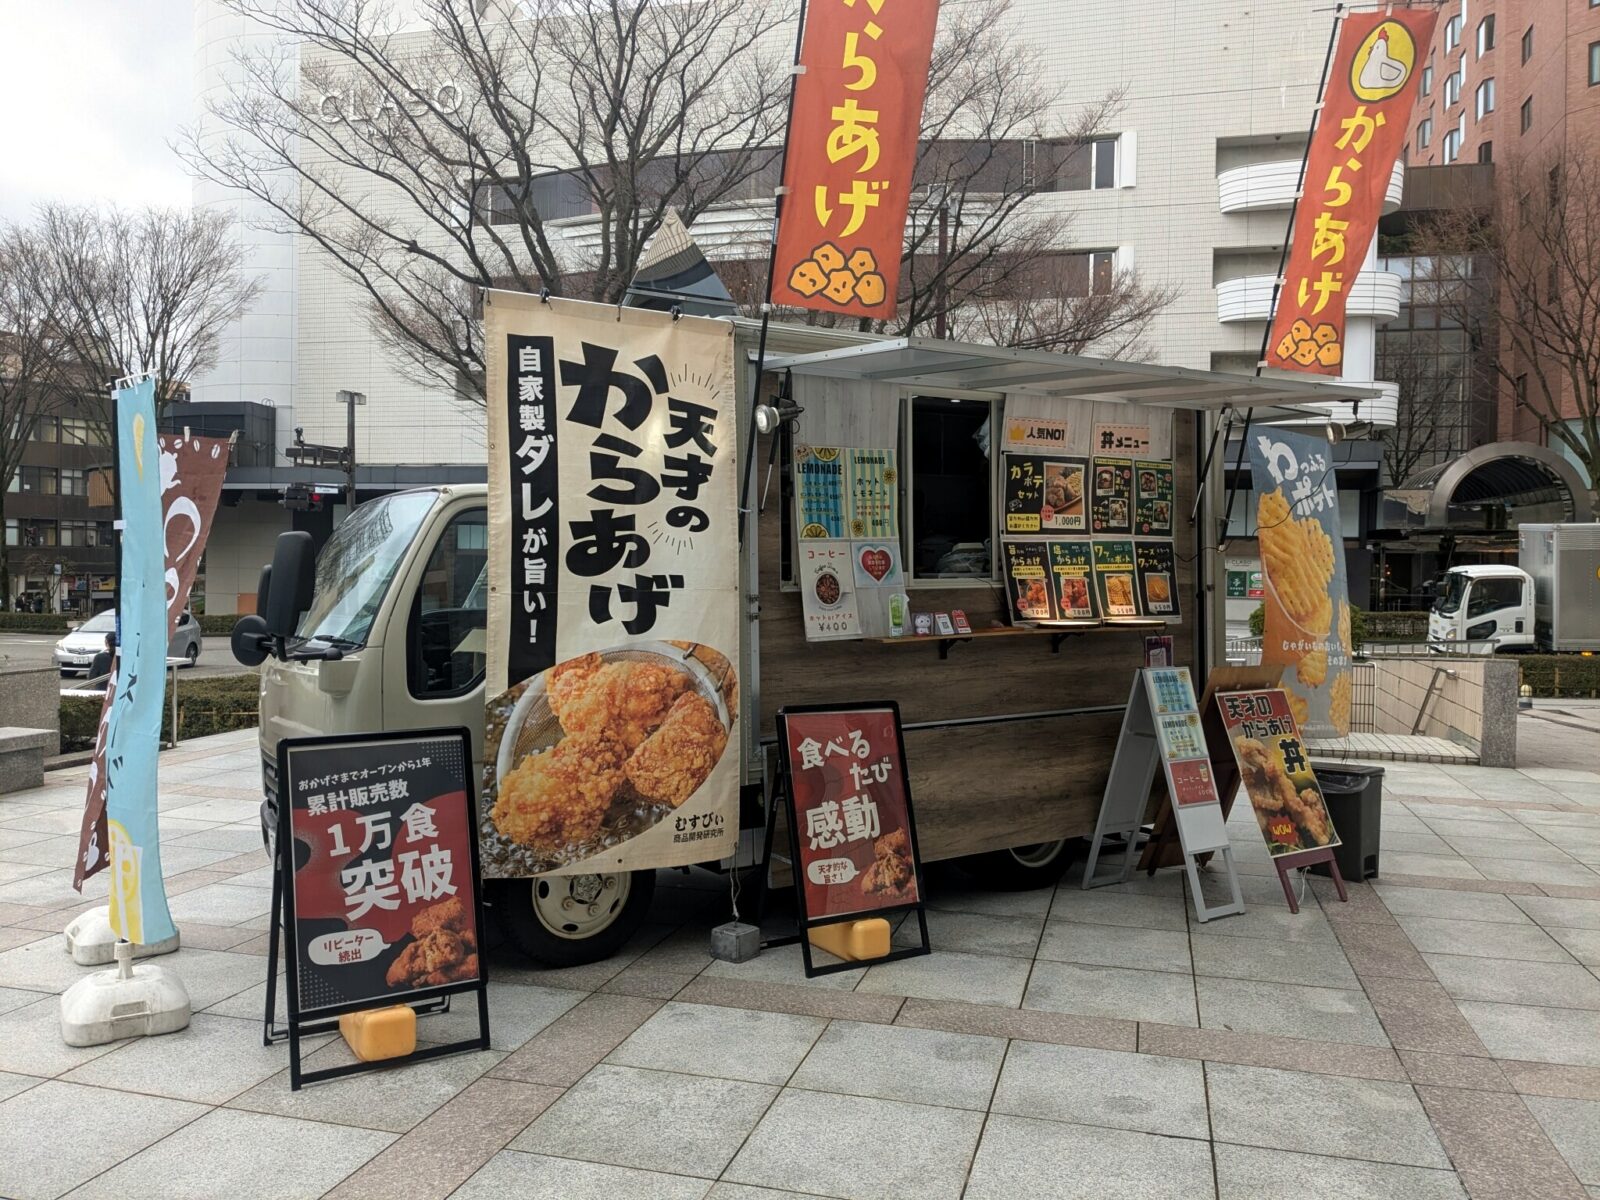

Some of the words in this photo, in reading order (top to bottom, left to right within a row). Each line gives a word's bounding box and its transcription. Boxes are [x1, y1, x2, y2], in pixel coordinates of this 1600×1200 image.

[814, 0, 889, 238] らあげ
[1298, 106, 1386, 316] からあげ
[1101, 430, 1149, 449] 丼メニュー
[660, 397, 718, 532] 天才の
[798, 463, 842, 475] LEMONADE
[559, 341, 684, 635] からあげ
[1292, 475, 1335, 516] ポテト
[1055, 516, 1081, 526] 1,000円
[808, 550, 846, 559] コーヒー
[1224, 696, 1273, 719] 天才の
[1242, 714, 1293, 739] からあげ
[797, 730, 871, 770] 食べる
[1278, 737, 1307, 774] 丼
[298, 757, 432, 791] おかげさまでオープンから1年
[849, 757, 893, 790] たび
[307, 778, 410, 817] 累計販売数
[327, 802, 440, 857] 1万食
[673, 828, 724, 843] 商品開発研究所
[805, 794, 881, 851] 感動
[341, 844, 459, 922] 突破
[817, 861, 848, 875] 天才的な
[323, 934, 374, 951] リピーター
[338, 948, 362, 964] 続出
